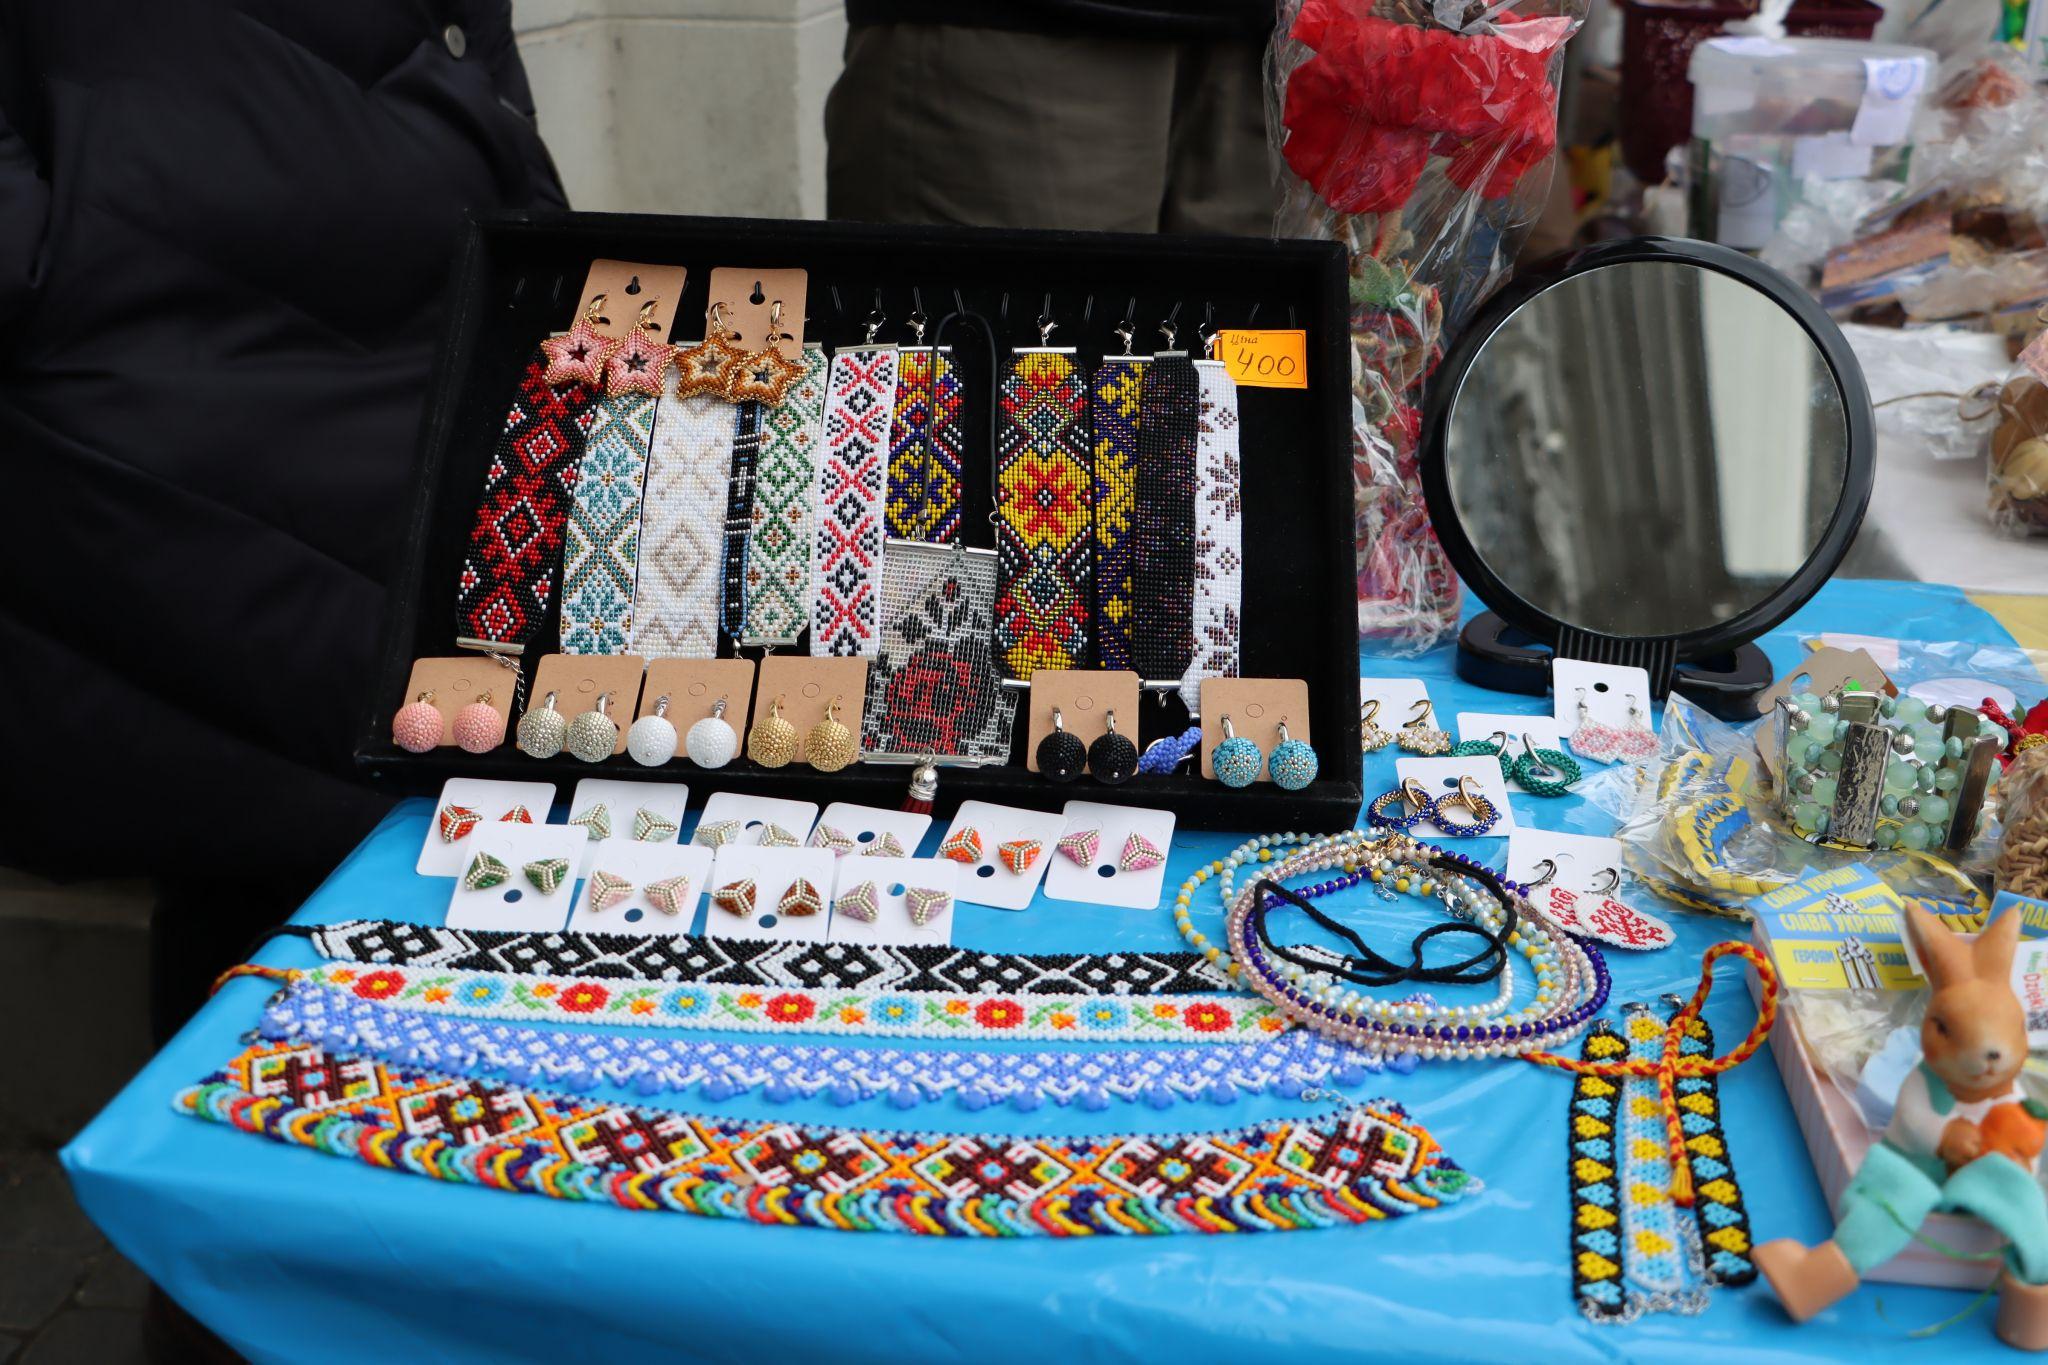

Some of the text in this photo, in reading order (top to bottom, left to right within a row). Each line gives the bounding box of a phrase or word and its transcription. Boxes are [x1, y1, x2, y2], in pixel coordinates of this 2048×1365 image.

[1230, 334, 1258, 346] Ціна
[1237, 347, 1296, 376] 400
[1779, 913, 1832, 933] СЛАВА
[1793, 949, 1836, 964] ГЕРОЯМ
